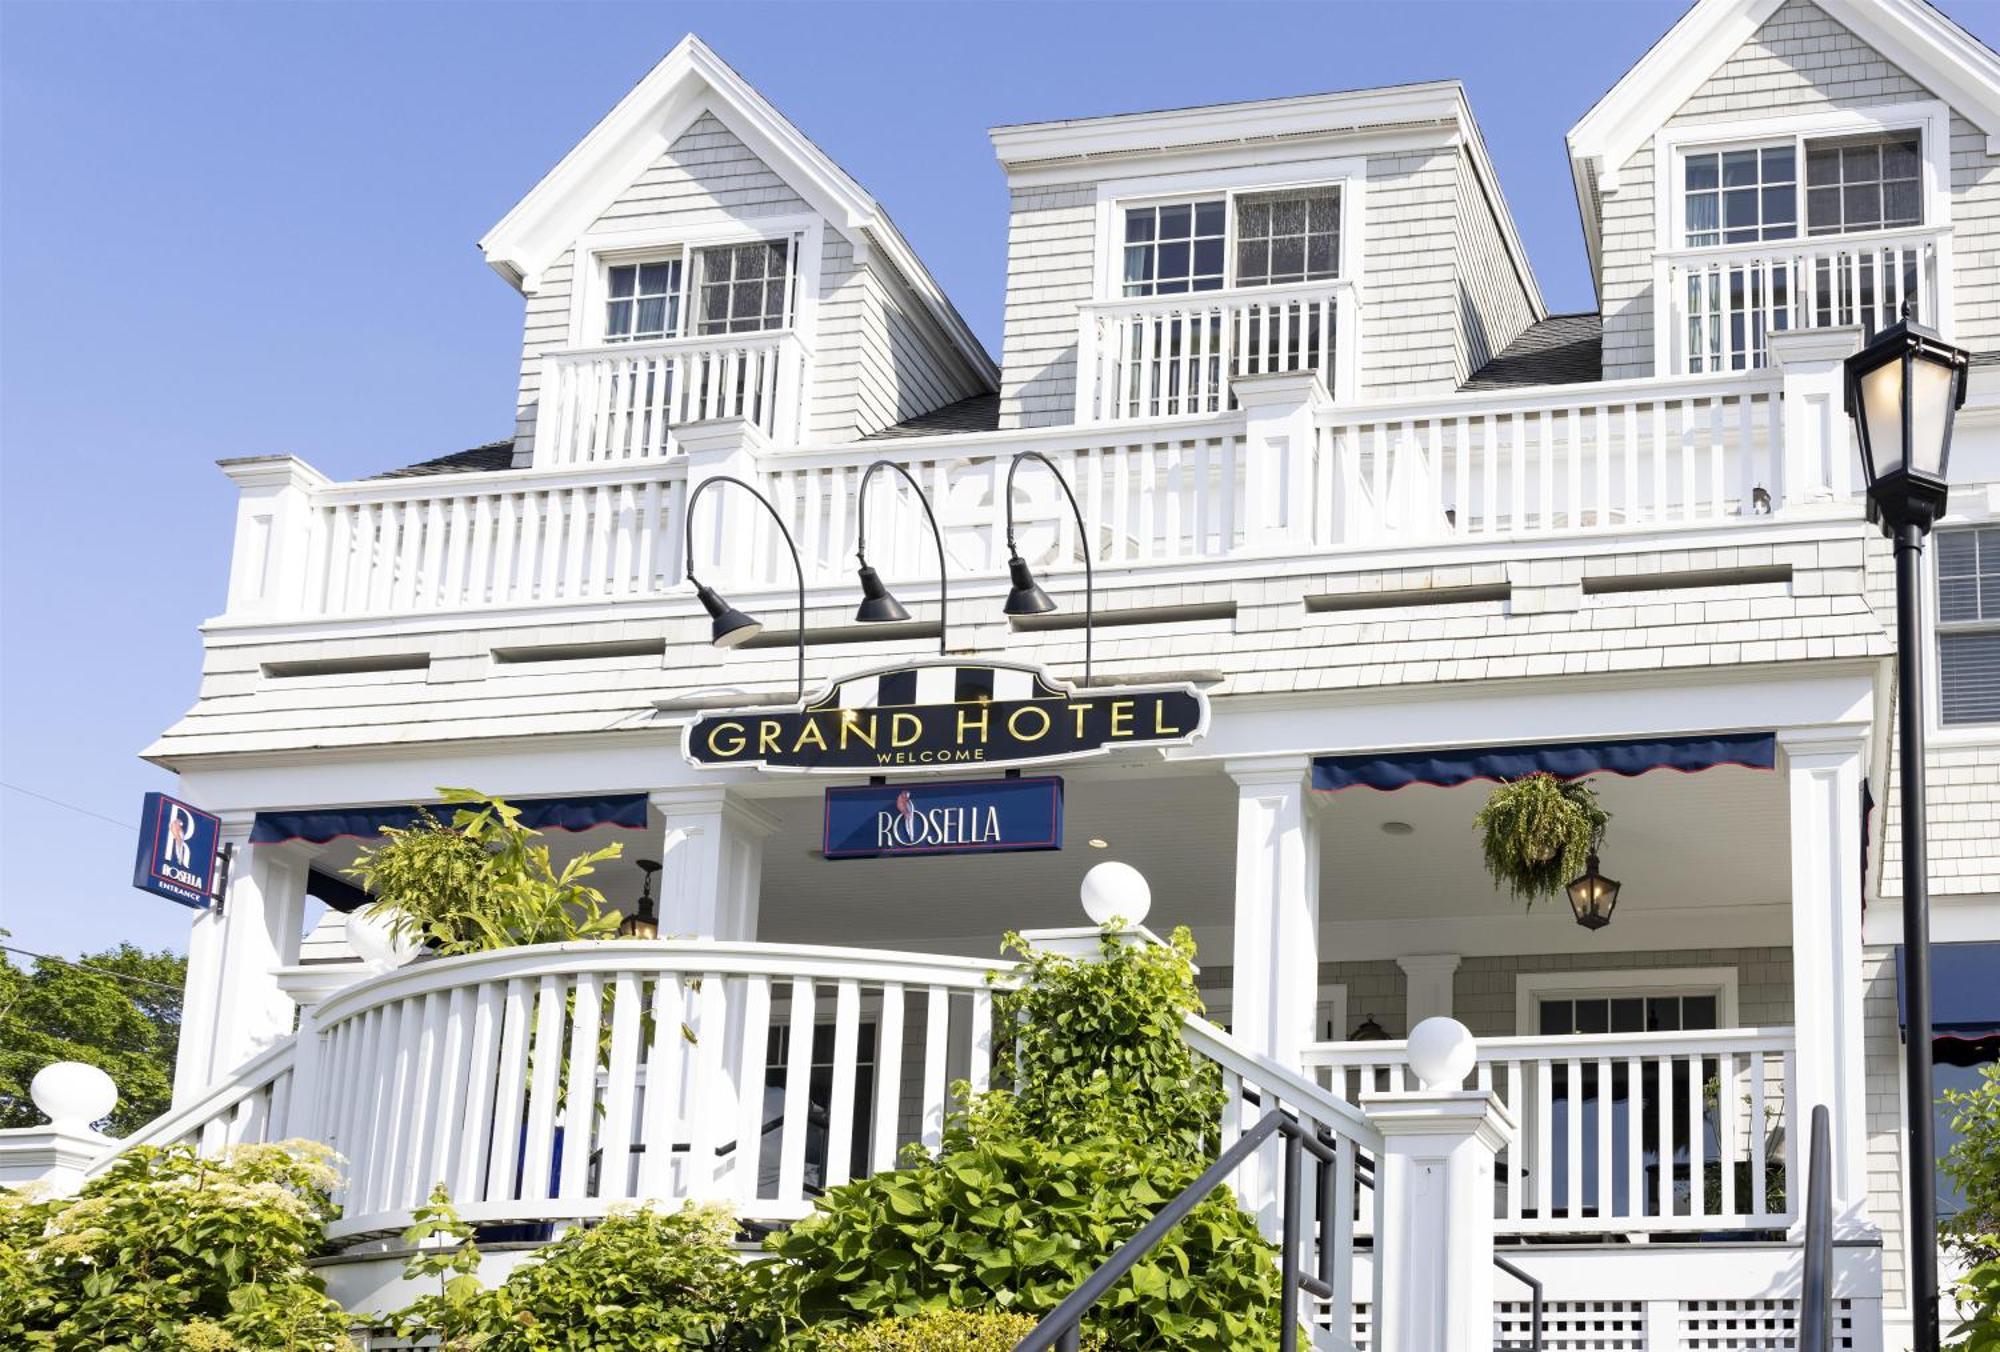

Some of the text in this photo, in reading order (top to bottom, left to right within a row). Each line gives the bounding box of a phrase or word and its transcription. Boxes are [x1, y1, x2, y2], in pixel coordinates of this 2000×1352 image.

[707, 698, 1180, 758] GRAND HOTEL
[876, 748, 985, 764] WELCOME
[165, 804, 195, 869] R
[877, 805, 1001, 848] ROSELLA
[160, 881, 201, 902] ENTRANCE
[162, 864, 202, 889] ROSELLA
